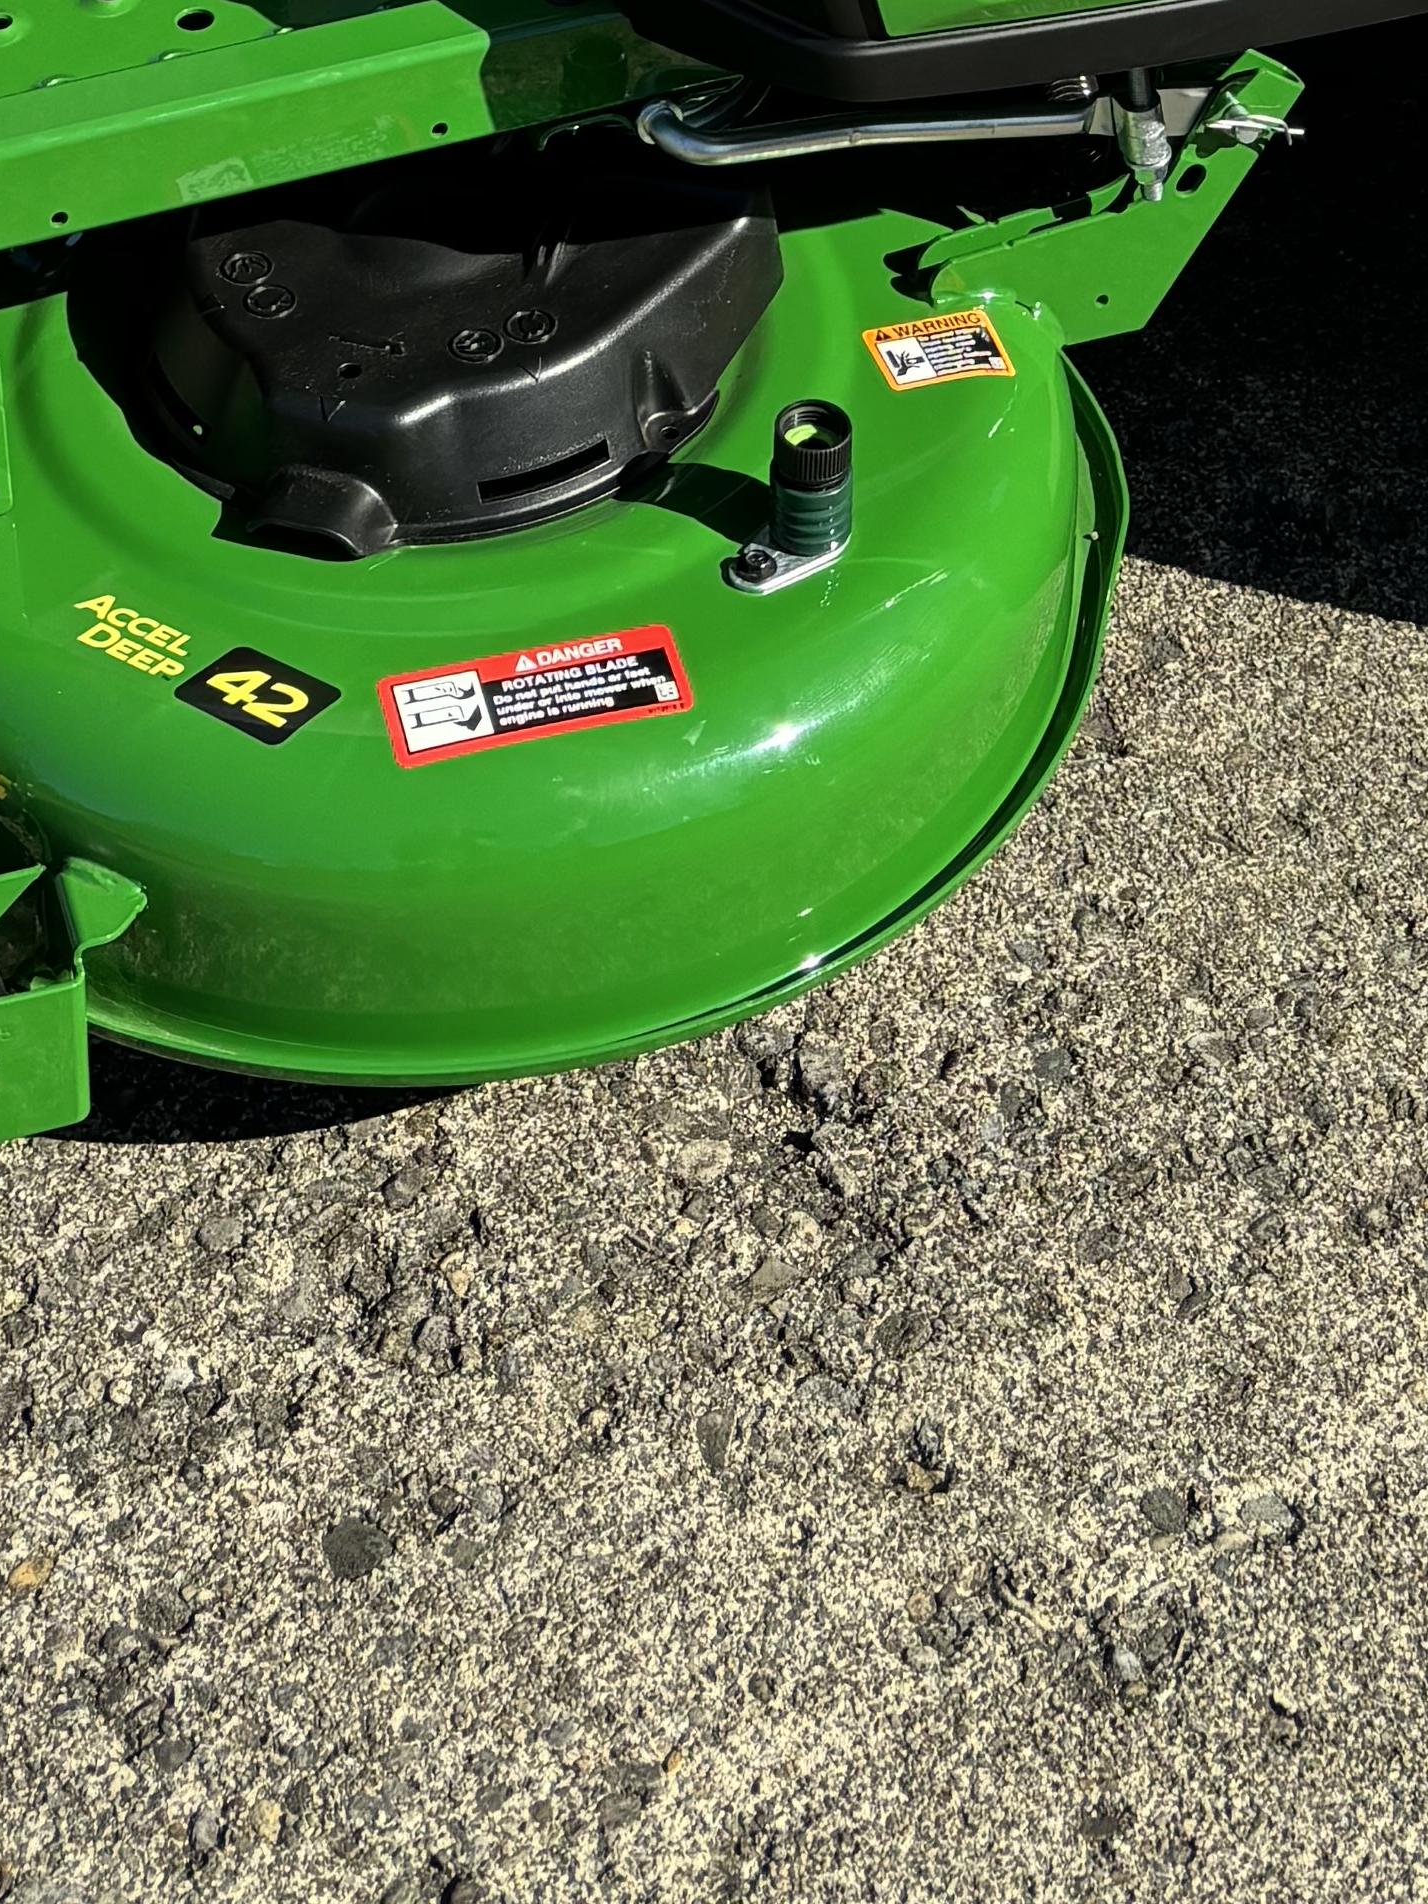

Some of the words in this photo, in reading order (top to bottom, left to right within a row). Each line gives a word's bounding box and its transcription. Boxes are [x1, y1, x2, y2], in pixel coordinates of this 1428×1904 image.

[892, 312, 981, 337] WARNING
[73, 594, 192, 657] ACCEL
[76, 622, 185, 677] DEEP
[536, 637, 623, 667] DANGER
[492, 695, 513, 706] Do
[515, 688, 538, 701] not
[539, 683, 563, 698] put
[564, 676, 606, 691] hands
[608, 673, 621, 682] or
[501, 667, 583, 692] ROTATING
[584, 655, 639, 675] BLADE
[206, 670, 310, 728] 42
[496, 700, 535, 716] under
[537, 697, 552, 707] or
[554, 692, 581, 704] into
[583, 682, 628, 698] mower
[630, 675, 666, 689] when
[499, 710, 545, 726] engine
[546, 706, 560, 717] is
[561, 696, 615, 714] running
